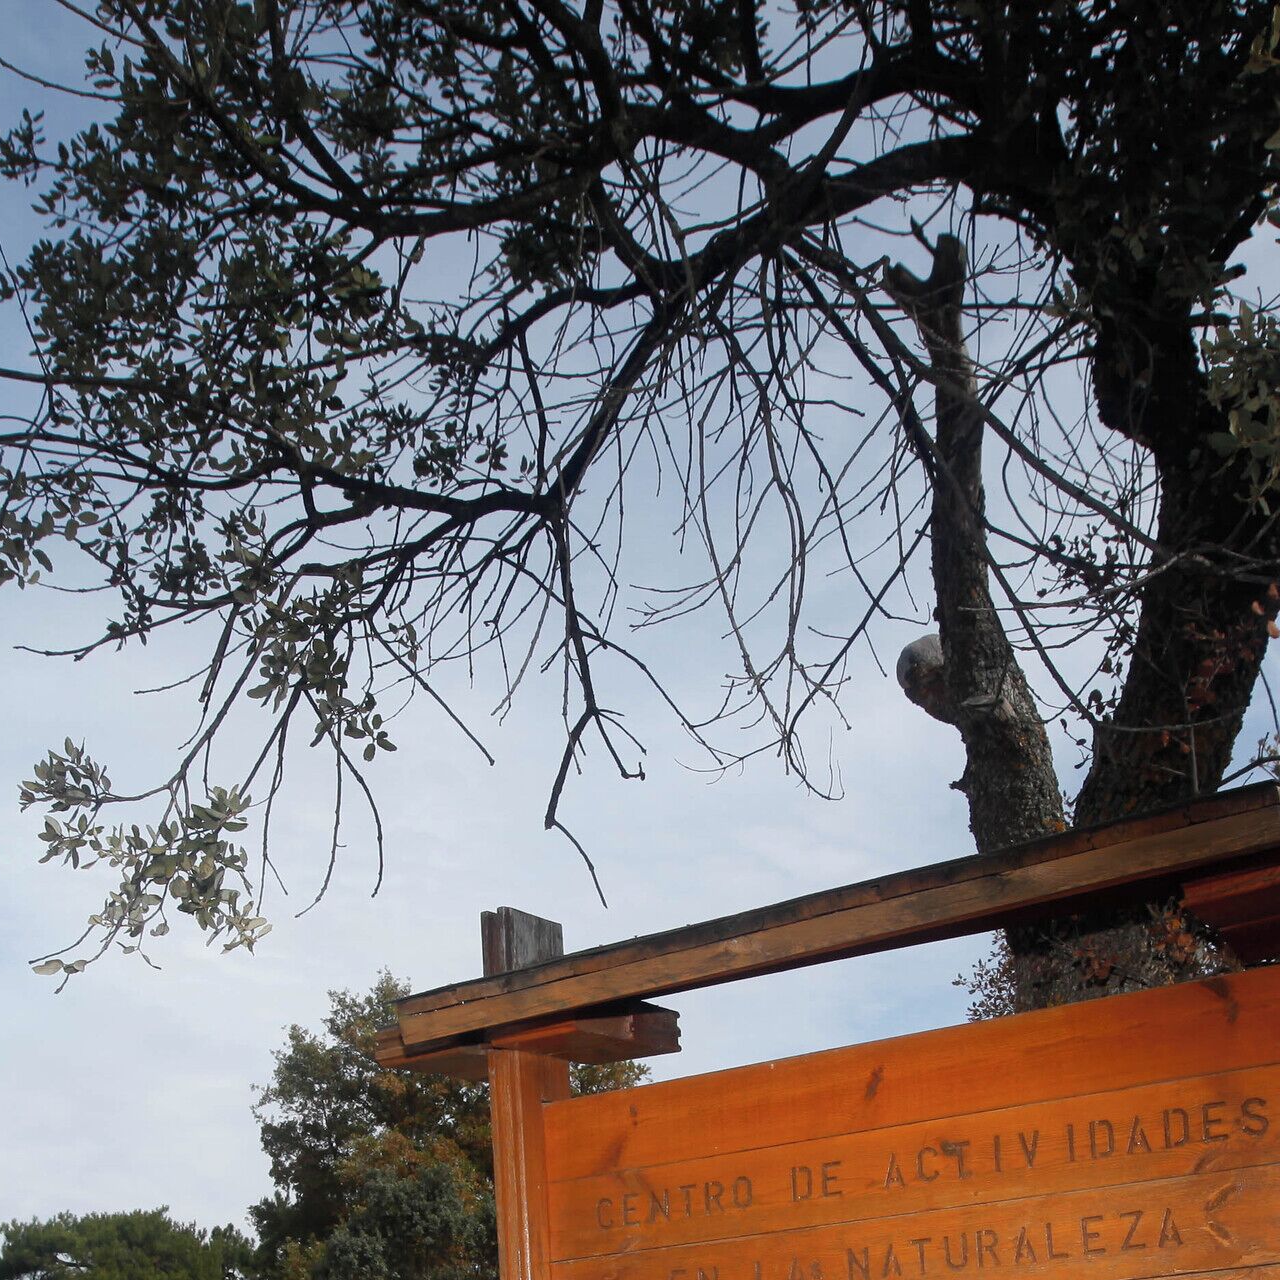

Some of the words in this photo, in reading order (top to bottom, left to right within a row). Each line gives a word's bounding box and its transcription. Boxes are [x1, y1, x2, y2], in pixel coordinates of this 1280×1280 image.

[594, 1174, 754, 1232] CENTRO
[790, 1160, 843, 1203] DE
[882, 1096, 1272, 1190] ACTIVIDADES
